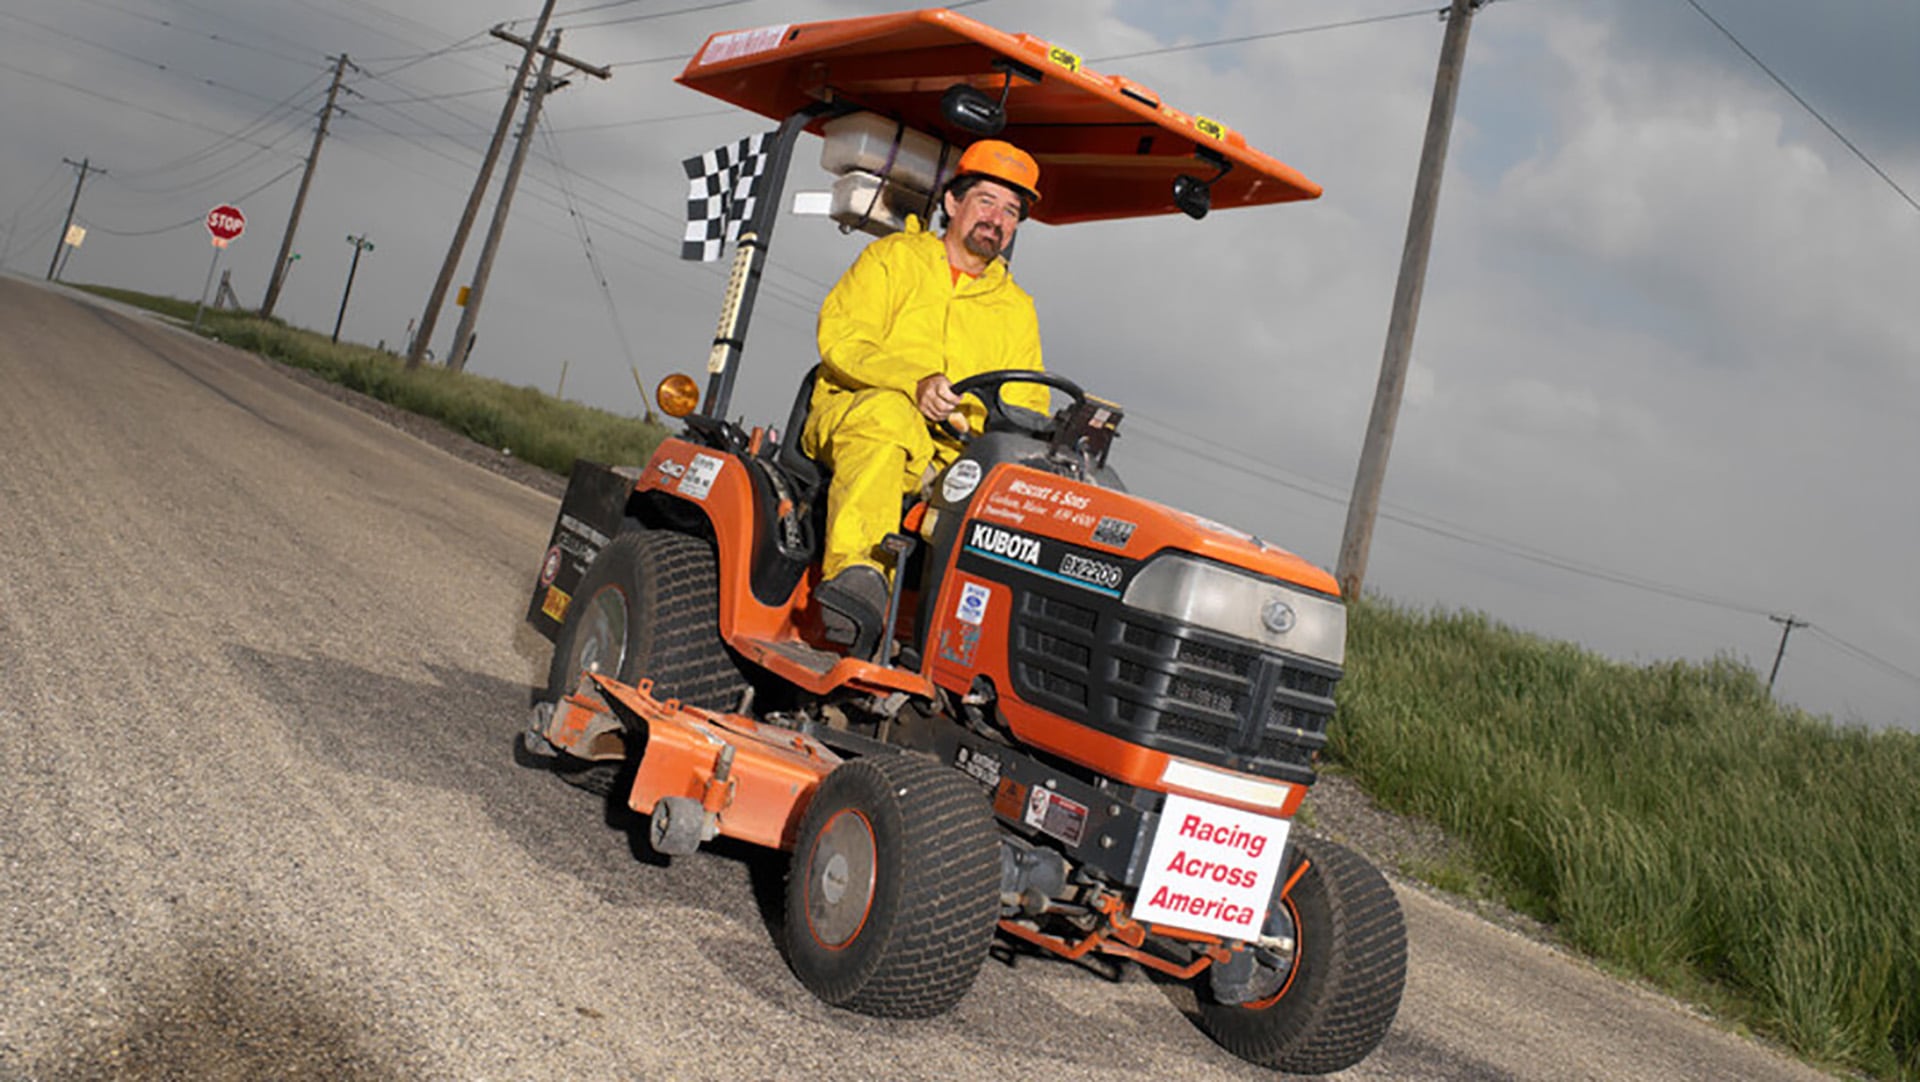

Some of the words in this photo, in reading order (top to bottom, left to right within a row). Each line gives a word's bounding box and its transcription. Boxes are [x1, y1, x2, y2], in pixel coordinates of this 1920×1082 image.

[210, 212, 244, 232] STOP
[1060, 491, 1092, 510] Sons
[970, 523, 1041, 565] KUBOTA
[1059, 553, 1123, 588] BX2200
[1178, 814, 1268, 858] Racing
[1166, 850, 1258, 888] Across
[1148, 885, 1255, 925] America
